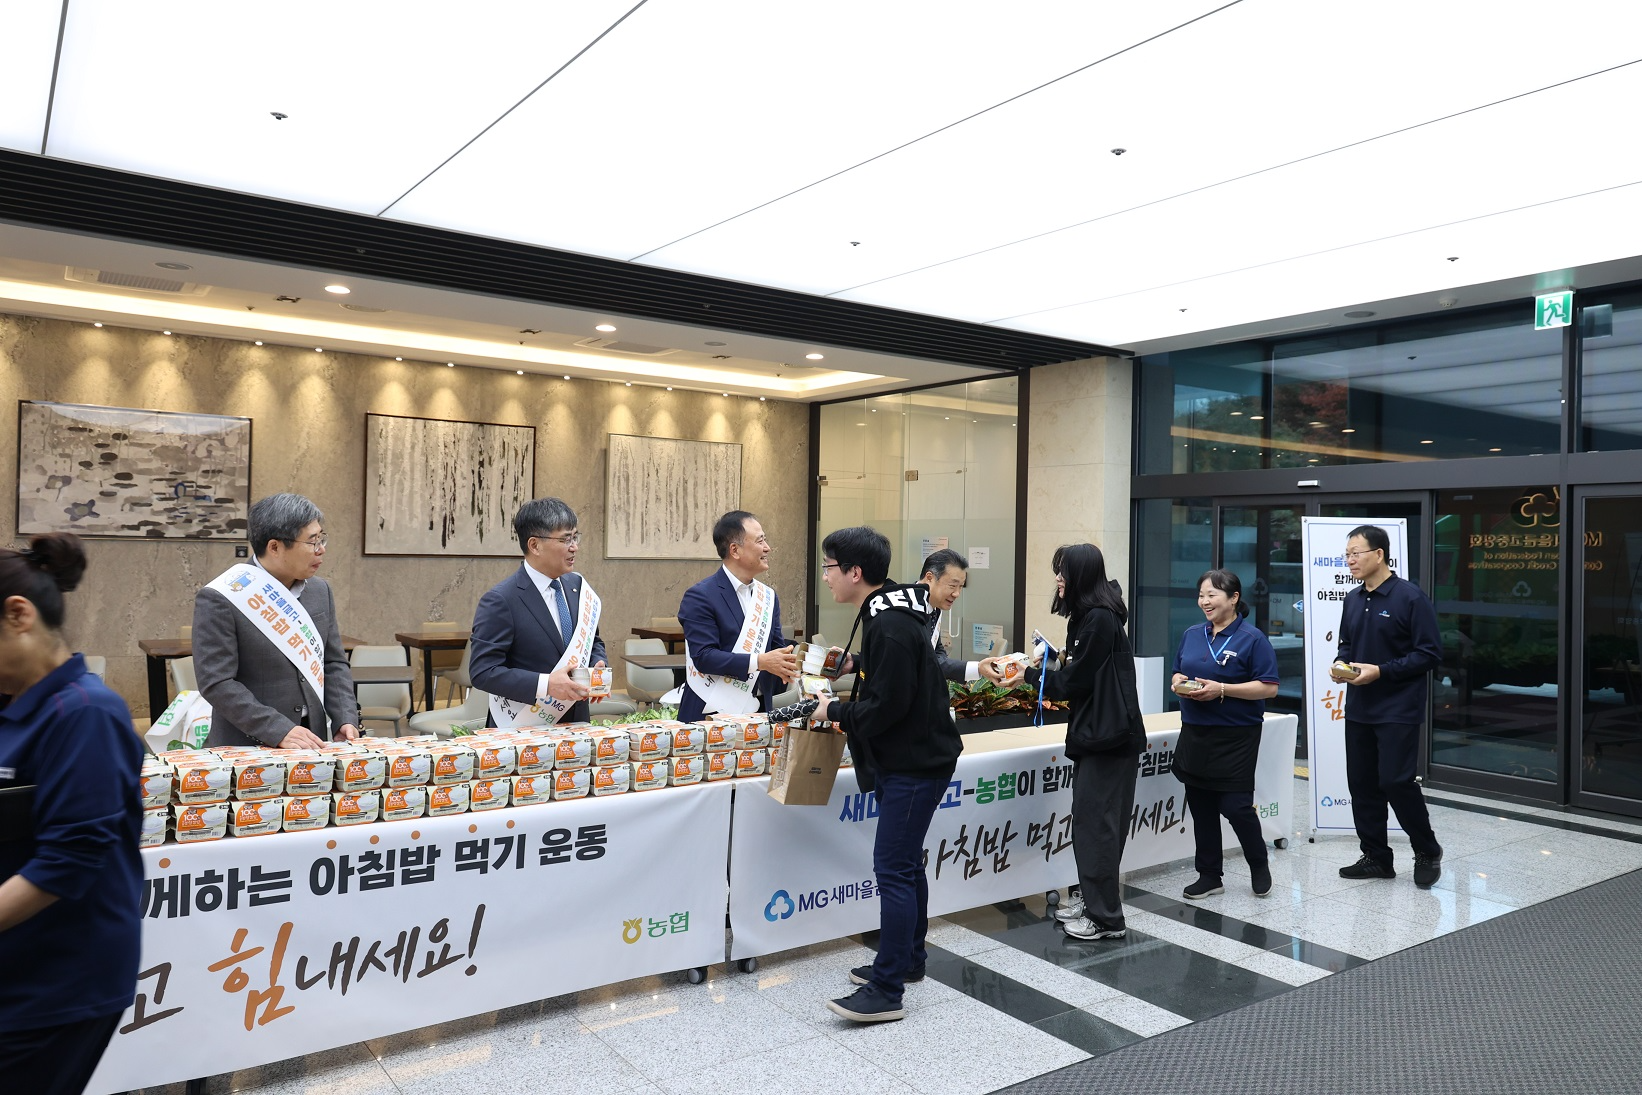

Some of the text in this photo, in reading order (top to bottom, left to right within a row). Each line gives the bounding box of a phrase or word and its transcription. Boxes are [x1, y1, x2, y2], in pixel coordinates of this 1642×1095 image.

[1259, 801, 1279, 820] 농협
[139, 824, 608, 919] 께하는 아침밥 먹기 운동
[798, 880, 881, 912] MG새마을
[646, 911, 690, 938] 농협
[119, 961, 185, 1035] 고
